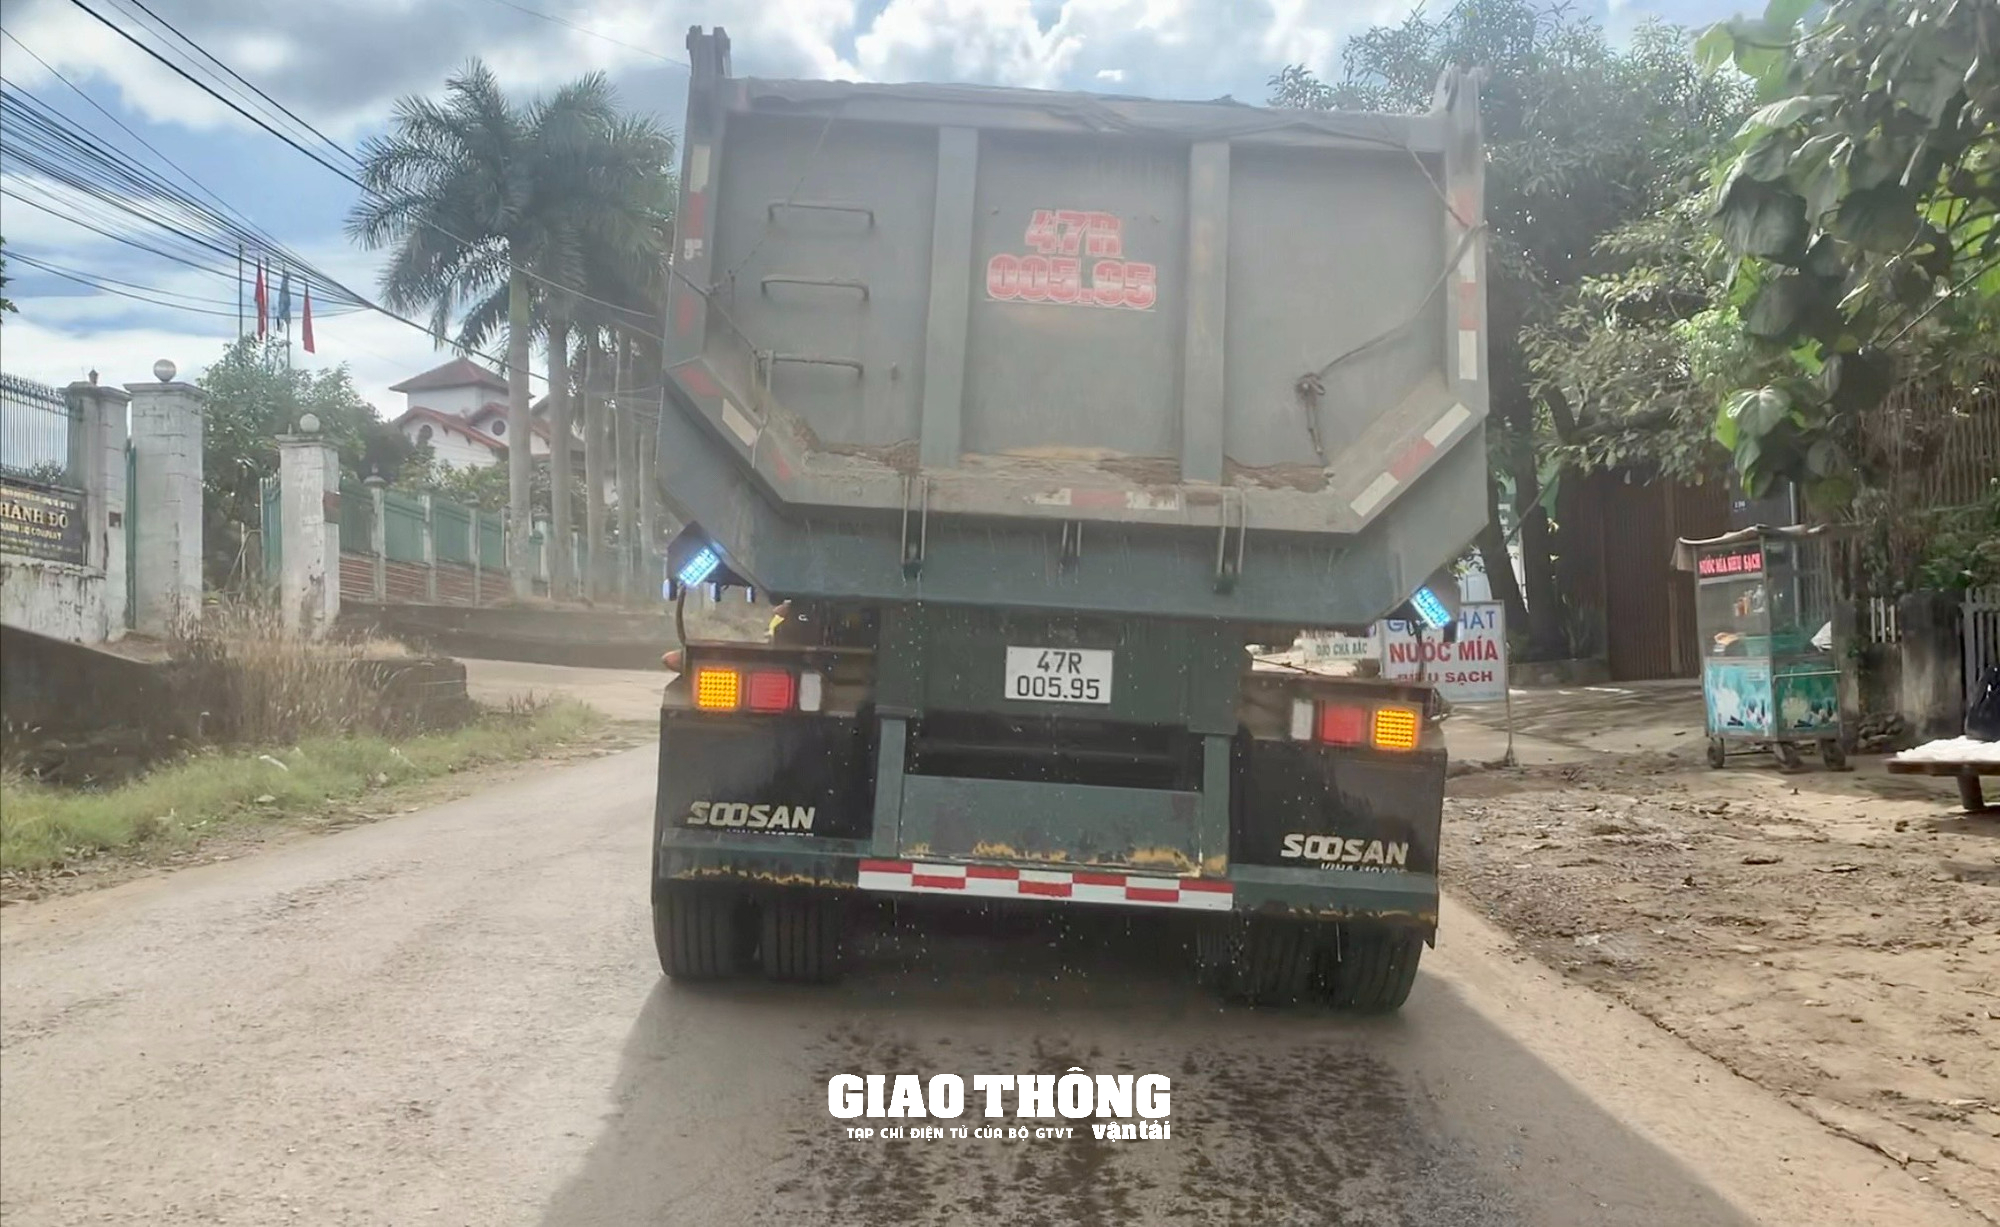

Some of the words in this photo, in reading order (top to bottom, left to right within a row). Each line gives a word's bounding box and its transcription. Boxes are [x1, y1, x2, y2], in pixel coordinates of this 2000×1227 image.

[1025, 209, 1121, 257] 47R
[986, 253, 1157, 309] 005.95
[1458, 635, 1499, 661] MÍA
[1037, 650, 1082, 674] 47R
[1017, 675, 1101, 700] 005.95
[1445, 671, 1493, 687] SẠCH
[687, 801, 816, 830] SOOSAN
[1280, 834, 1409, 865] SOOSAN
